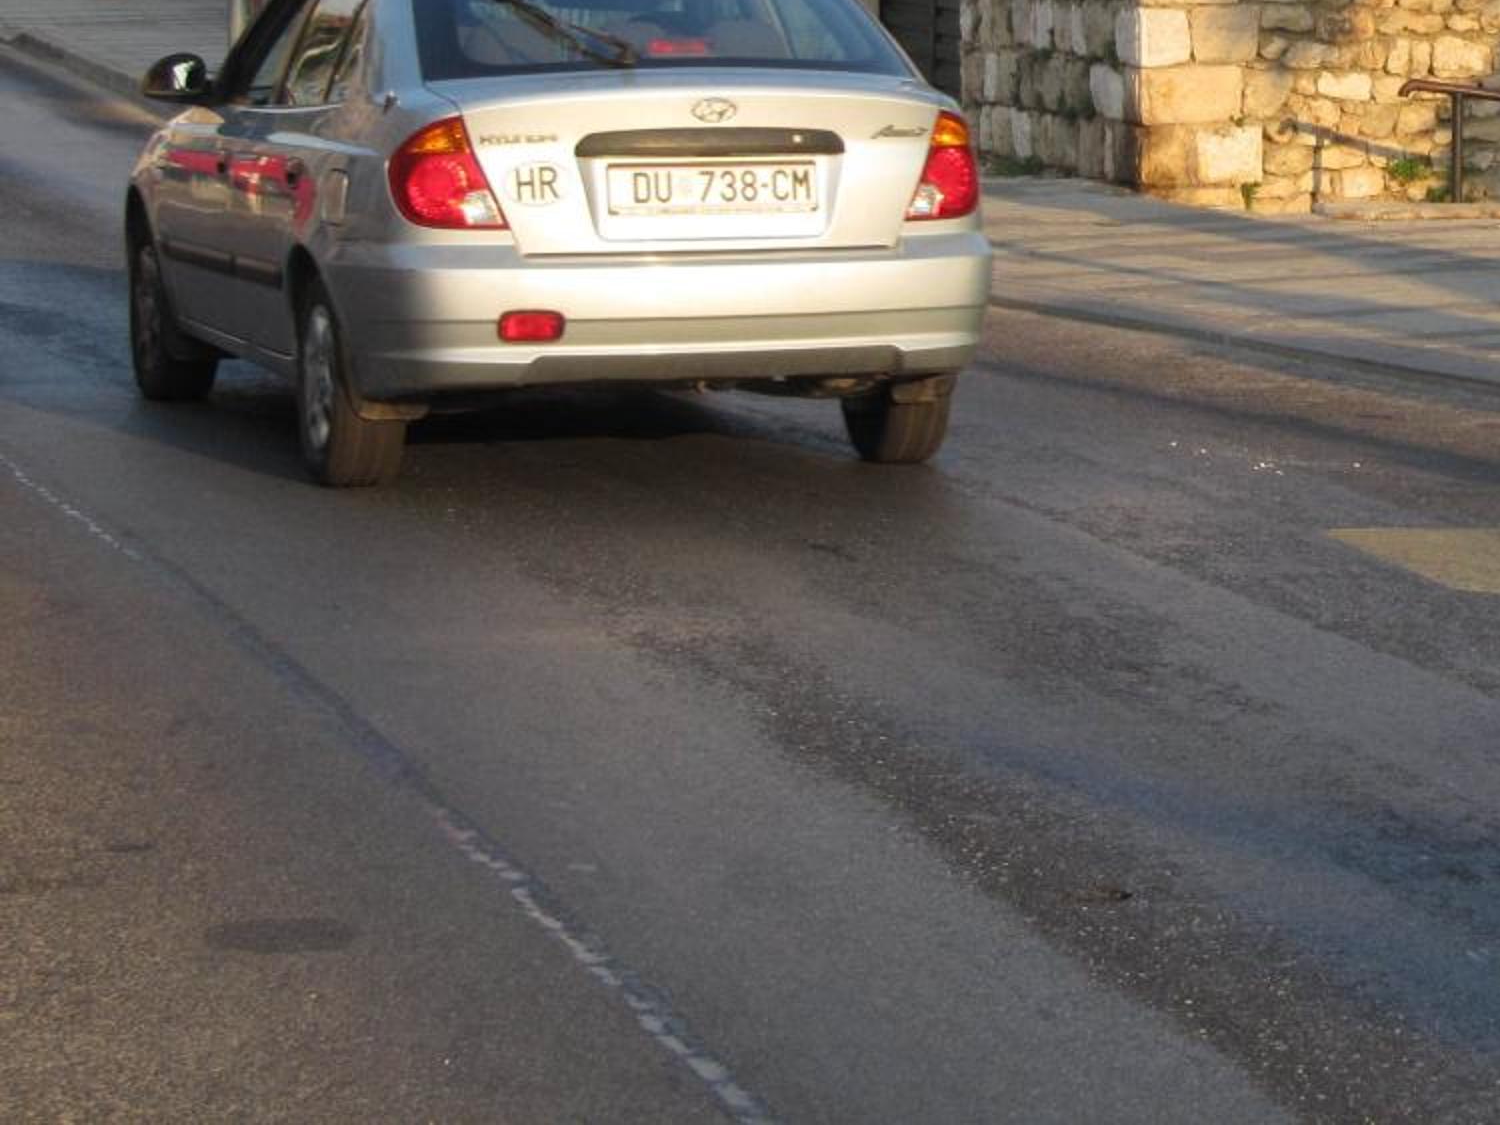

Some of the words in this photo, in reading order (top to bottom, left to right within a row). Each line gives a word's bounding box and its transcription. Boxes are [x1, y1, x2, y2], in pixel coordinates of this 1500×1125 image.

[515, 166, 560, 201] HR
[633, 172, 672, 204] DU
[699, 169, 811, 202] 738-CM
